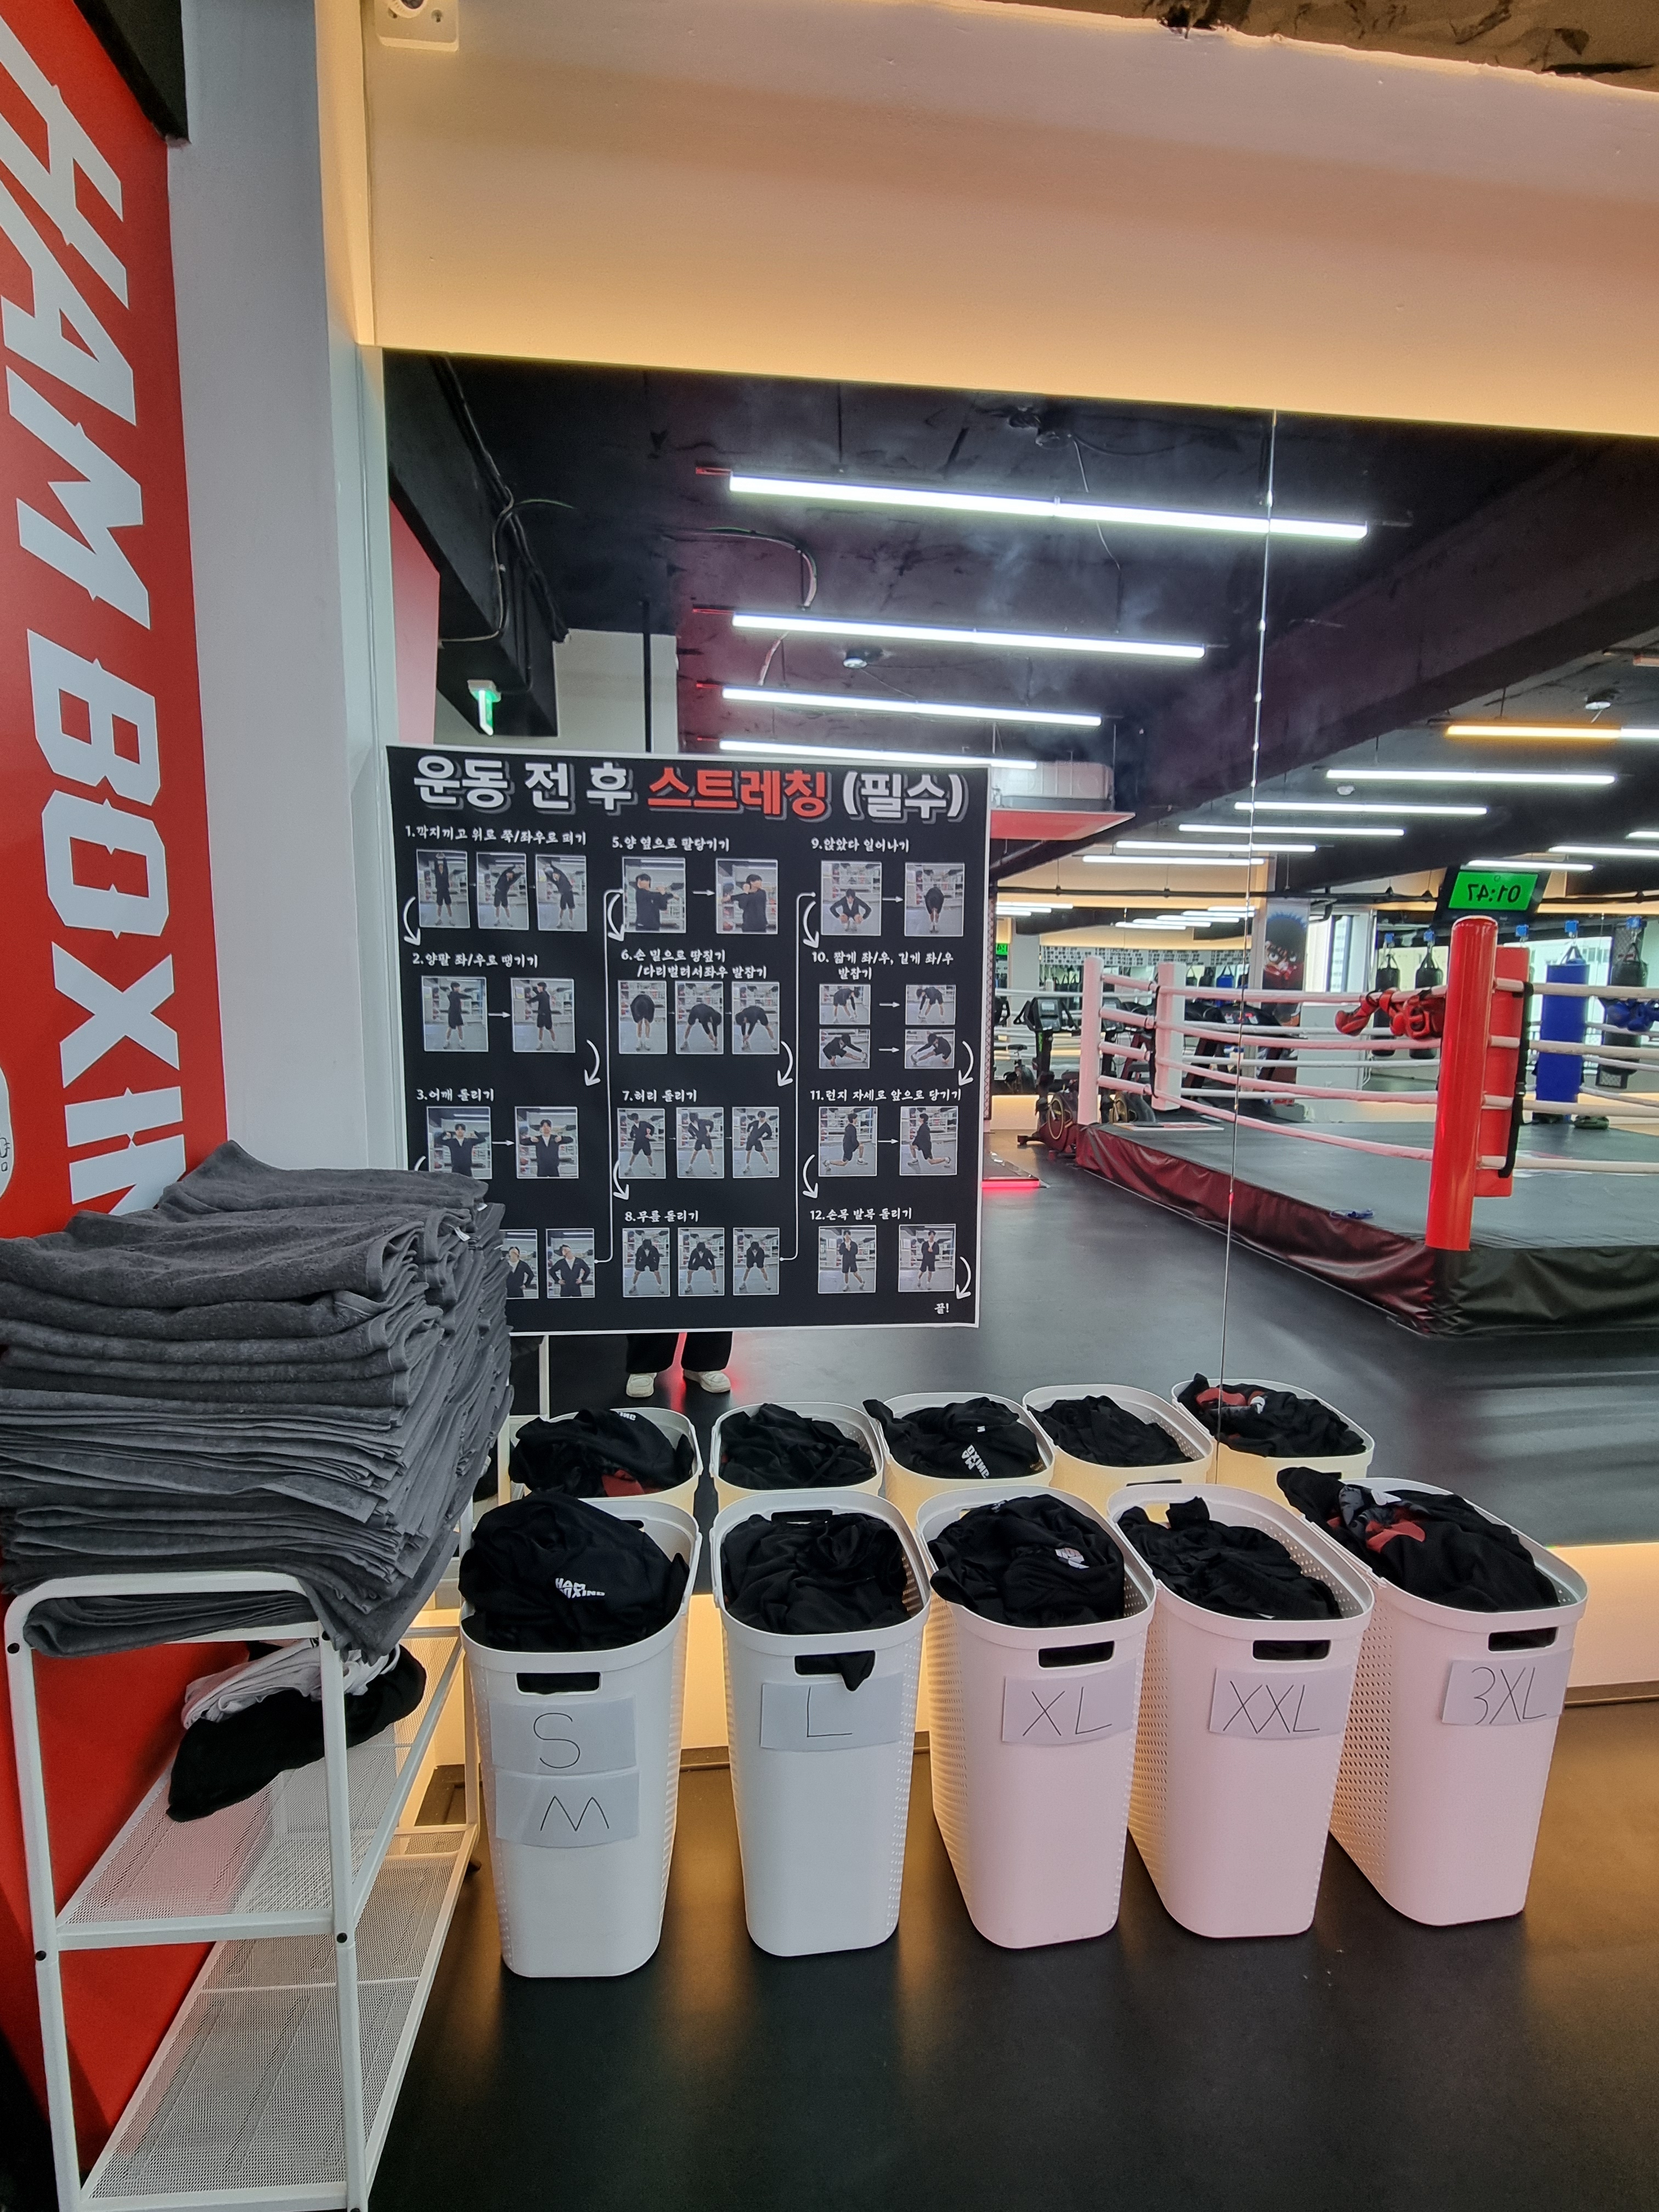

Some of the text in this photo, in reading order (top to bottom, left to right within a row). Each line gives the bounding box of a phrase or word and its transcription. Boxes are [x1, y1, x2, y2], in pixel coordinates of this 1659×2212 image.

[414, 755, 964, 819] 운동 전 후 스트레칭 (필수)
[472, 827, 496, 842] 위로
[500, 829, 558, 845] 쭉/좌우로
[562, 831, 586, 845] 펴기
[612, 835, 730, 852] 5.양 옆으로 팔당기기
[811, 837, 909, 853] 9.앉았다 일어나기
[412, 952, 451, 967] 2.양팔
[454, 952, 498, 967] 좌/우로
[620, 948, 646, 961] 6.손
[650, 948, 687, 962] 밑으로
[811, 951, 830, 963] 10.
[861, 951, 894, 966] 좌/우,
[898, 951, 921, 965] 길게
[925, 951, 954, 966] 좌/우
[732, 965, 767, 979] 발잡기
[838, 966, 872, 980] 발잡기
[416, 1087, 494, 1102] 3.어깨 돌리기
[622, 1088, 697, 1103] 7.허리 돌리기
[810, 1088, 961, 1102] 11.런지 자세로 앞으로 당기기
[624, 1209, 698, 1223] 8.무릎 돌리기
[810, 1207, 912, 1221] 12.손목 발목 돌리기
[934, 1302, 949, 1314] 끝!
[1471, 1666, 1547, 1725] 3XL
[806, 1686, 853, 1738] L
[1022, 1686, 1113, 1737] XL
[1222, 1680, 1321, 1735] XXL
[533, 1712, 580, 1769] S
[540, 1796, 610, 1832] M
